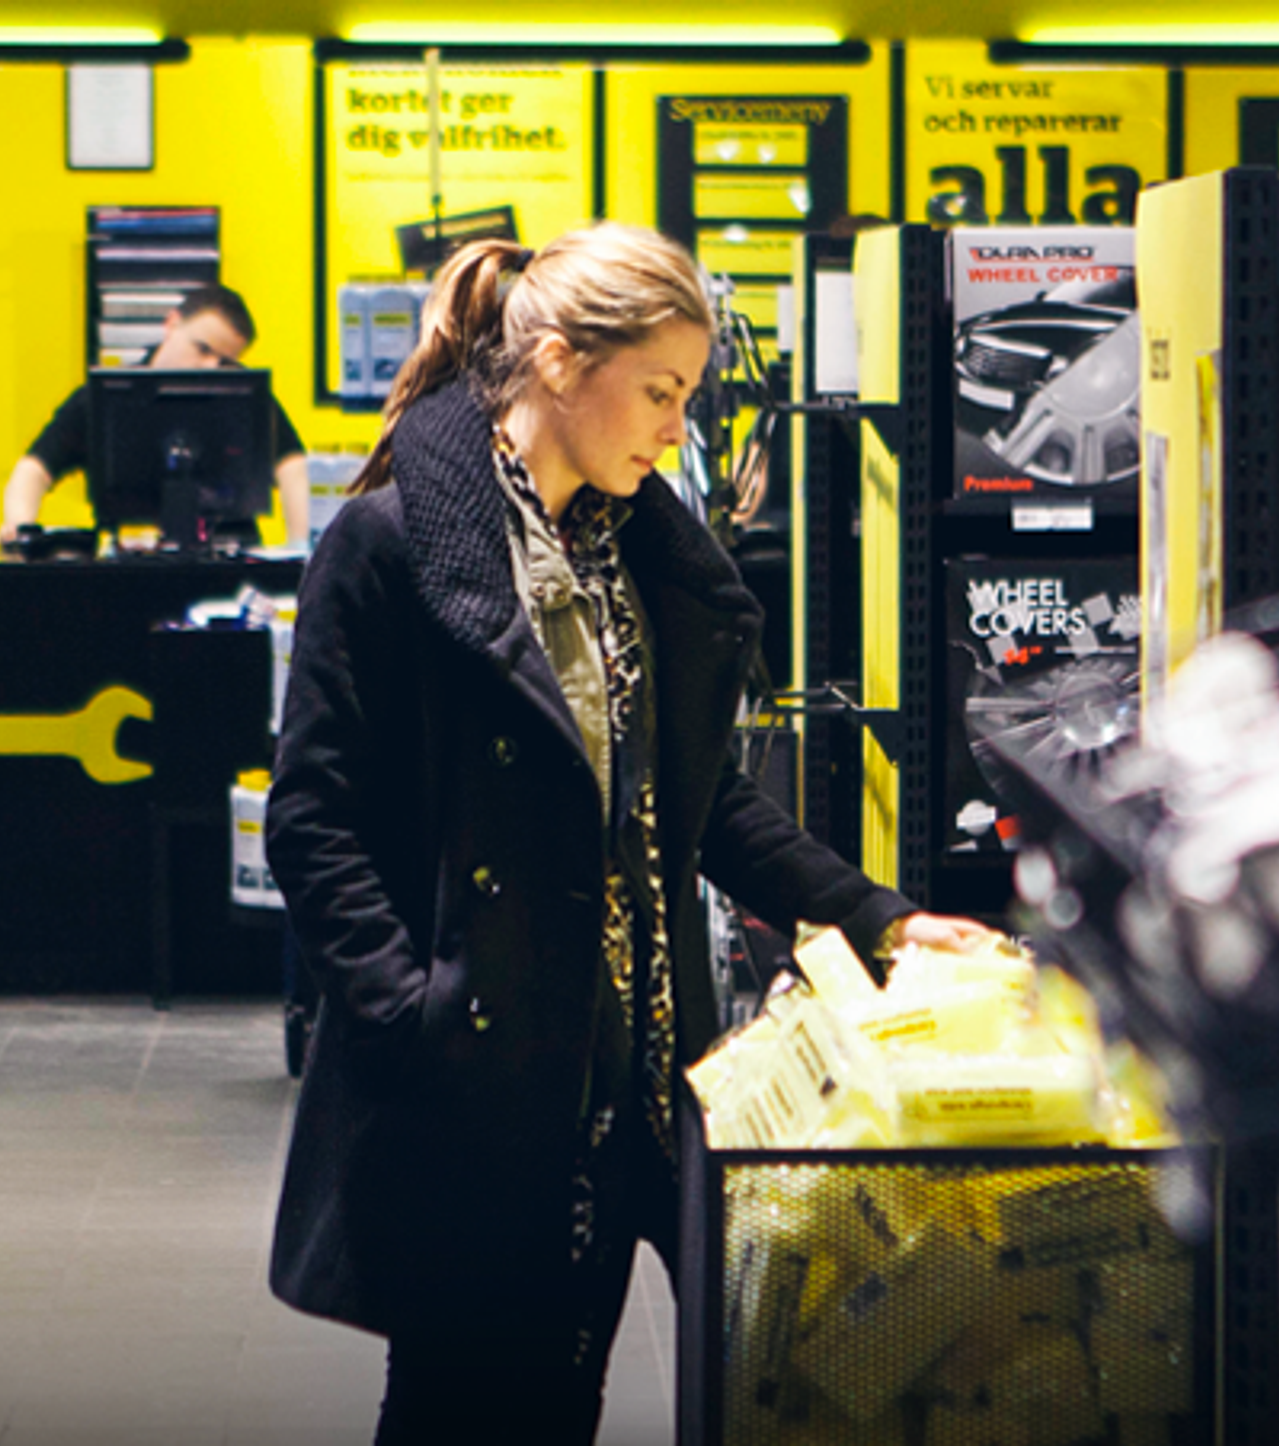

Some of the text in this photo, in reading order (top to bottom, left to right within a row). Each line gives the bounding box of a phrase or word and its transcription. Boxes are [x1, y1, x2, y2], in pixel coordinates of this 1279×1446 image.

[925, 76, 1055, 98] Vi servar
[460, 93, 514, 119] ger
[924, 109, 1123, 137] och reparerar
[347, 124, 568, 158] dig vlfrihet.
[925, 143, 1142, 226] alla
[967, 267, 1119, 283] WHEEL COVER
[964, 475, 1034, 491] Premium
[967, 579, 1068, 607] WHEEL
[969, 607, 1087, 636] COVERS
